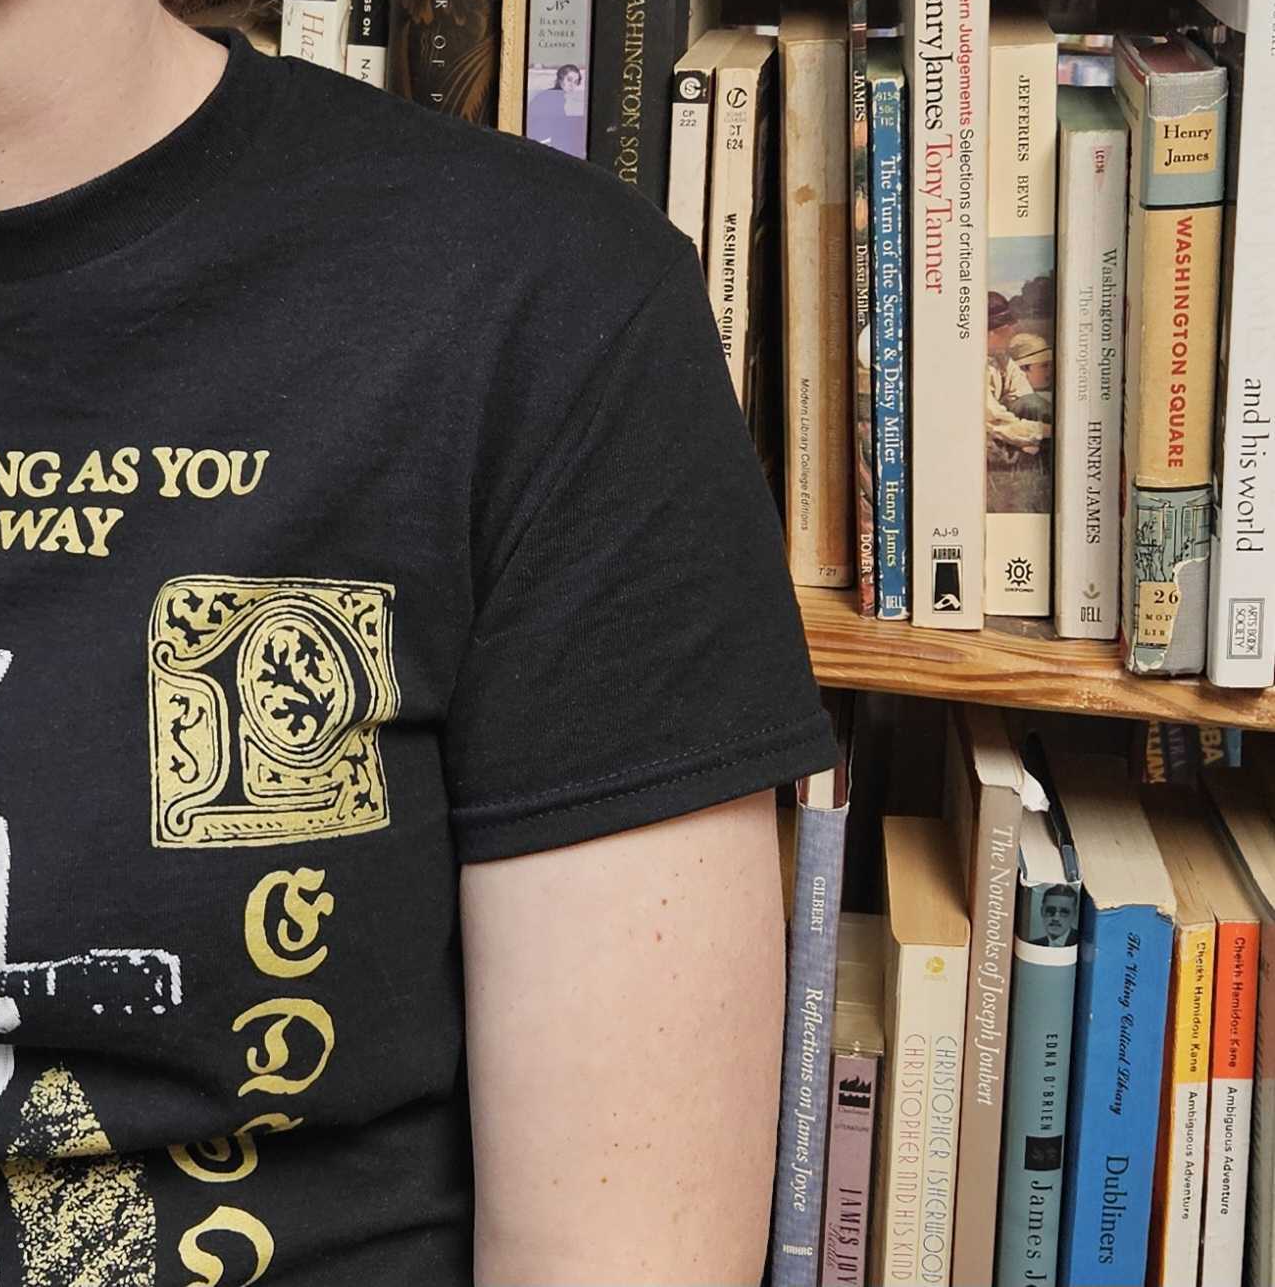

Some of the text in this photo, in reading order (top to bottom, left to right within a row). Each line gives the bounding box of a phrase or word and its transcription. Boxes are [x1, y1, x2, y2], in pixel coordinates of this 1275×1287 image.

[363, 17, 373, 36] ON
[432, 34, 447, 68] OF
[919, 54, 953, 131] James
[955, 24, 973, 125] Judgements
[919, 134, 952, 202] Tony
[958, 129, 975, 211] Selections
[1163, 124, 1212, 141] Henry
[925, 207, 952, 294] Tanner
[959, 214, 974, 229] of
[959, 233, 974, 284] critical
[956, 288, 972, 339] essays
[1097, 249, 1117, 401] Washington Square
[1167, 215, 1193, 468] WASHINGTON SQUARE
[72, 449, 141, 494] AS
[150, 449, 270, 499] YOU
[798, 378, 812, 531] Modern Library College Editions
[1235, 378, 1270, 552] and his world
[977, 826, 1015, 1105] The Notebooks of Joseph Joubert
[793, 876, 825, 1211] GILBERT Reflections on James Joyce
[922, 1035, 957, 1285] CHRISTOPHER ISHERWOOD
[840, 1188, 864, 1245] JAMES
